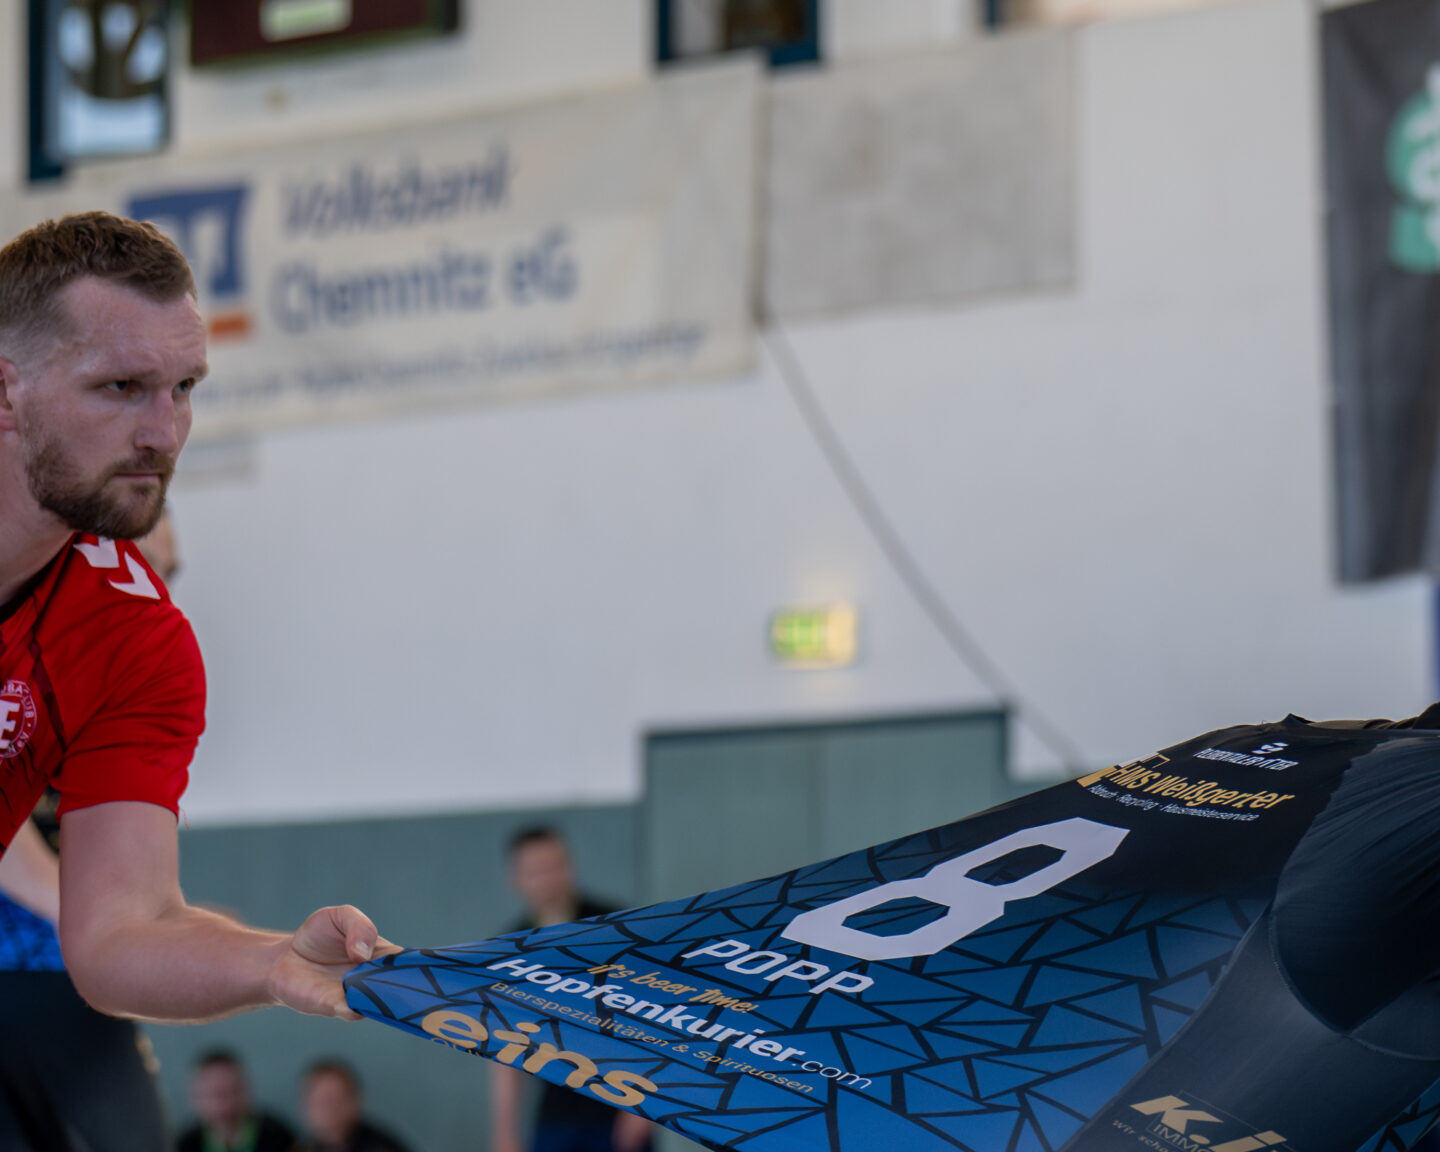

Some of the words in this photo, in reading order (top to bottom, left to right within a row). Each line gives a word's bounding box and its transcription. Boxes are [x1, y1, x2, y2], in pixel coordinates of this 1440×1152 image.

[1104, 764, 1161, 789] HMS
[780, 817, 1130, 962] 8
[587, 964, 636, 979] it's
[629, 971, 698, 995] beer
[688, 989, 760, 1013] time!
[681, 939, 875, 994] POPP
[421, 1010, 659, 1107] eins
[486, 958, 873, 1090] Hopfenkurier.com
[490, 982, 670, 1047] Bierspezialitäten
[672, 1040, 690, 1054] &
[692, 1050, 814, 1093] Spirituosen
